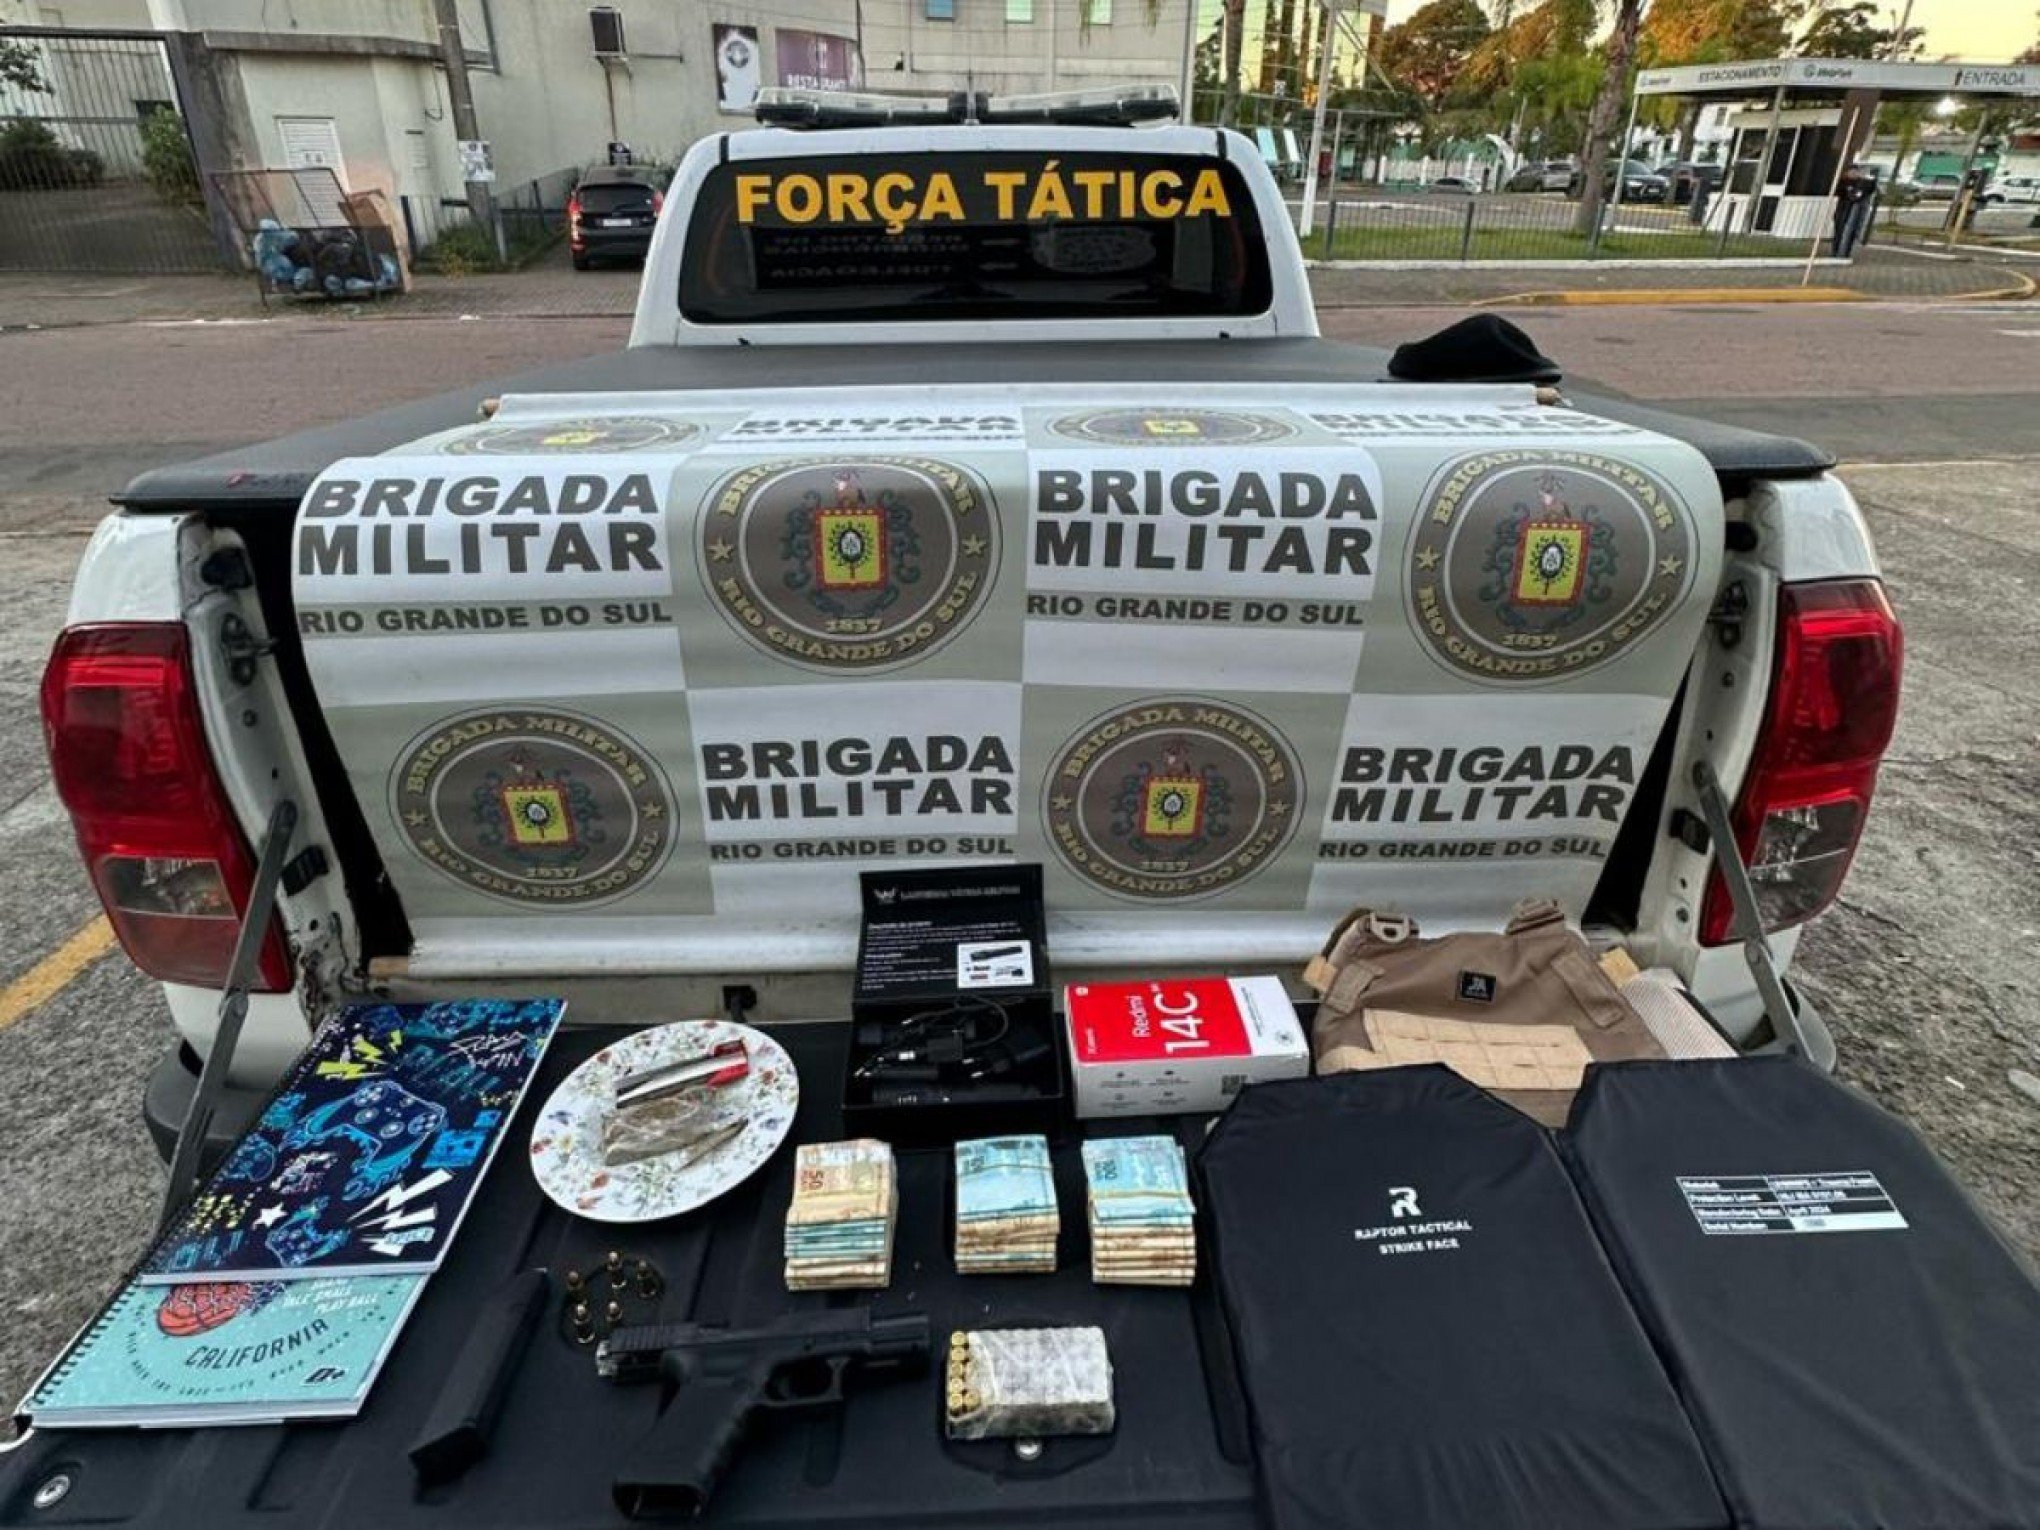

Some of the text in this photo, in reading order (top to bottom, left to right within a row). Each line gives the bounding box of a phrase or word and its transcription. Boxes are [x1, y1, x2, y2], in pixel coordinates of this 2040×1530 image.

[1964, 70, 2027, 86] ENTRADA
[735, 162, 1232, 234] FORÇA TÁTICA
[304, 473, 659, 519] BRIGADA
[1037, 470, 1378, 520] BRIGADA
[1432, 451, 1675, 531] BRIGADA MILITAR
[299, 521, 663, 576] MILITAR
[1034, 520, 1373, 576] MILITAR
[300, 602, 673, 634] RIO GRANDE DO SUL
[719, 572, 978, 660] RIO GRANDE DO SUL
[1026, 594, 1364, 626] RIO GRANDE DO SUL
[1446, 635, 1559, 673] GRANDE
[1564, 640, 1608, 667] DO
[406, 717, 648, 795] BRIGADA MILITAR
[701, 735, 1015, 780] BRIGADA
[1064, 707, 1285, 784] BRIGADA MILITAR
[1340, 744, 1635, 785] BRIGADA
[706, 777, 1014, 821] MILITAR
[1331, 784, 1626, 822] MILITAR
[709, 837, 1014, 861] RIO GRANDE DO SUL
[1318, 837, 1607, 858] RIO GRANDE DO SUL
[471, 870, 591, 897] GRANDE
[595, 869, 628, 893] DO
[1087, 862, 1194, 892] GRANDE
[1199, 865, 1233, 887] DO
[1128, 995, 1151, 1038] Redmi
[1154, 991, 1210, 1053] 14C
[1388, 1187, 1422, 1218] R
[1354, 1219, 1473, 1240] RAPTOR TACTICAL
[1379, 1237, 1460, 1255] STRIKE FACE
[185, 1318, 329, 1369] CALIFORNIA
